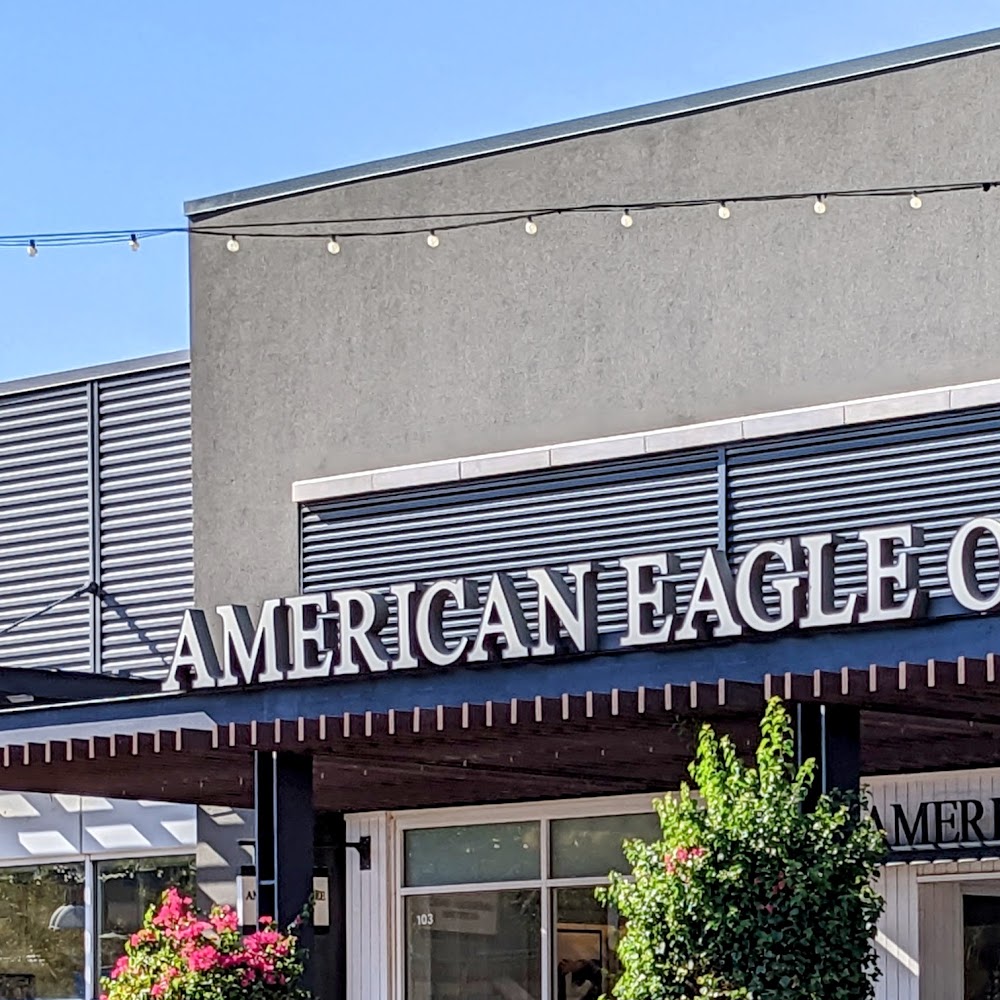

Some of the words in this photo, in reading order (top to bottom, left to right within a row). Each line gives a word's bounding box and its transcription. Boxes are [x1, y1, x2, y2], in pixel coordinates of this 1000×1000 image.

[162, 562, 596, 692] AMERICAN
[619, 525, 918, 647] EAGLE
[416, 914, 434, 926] 103
